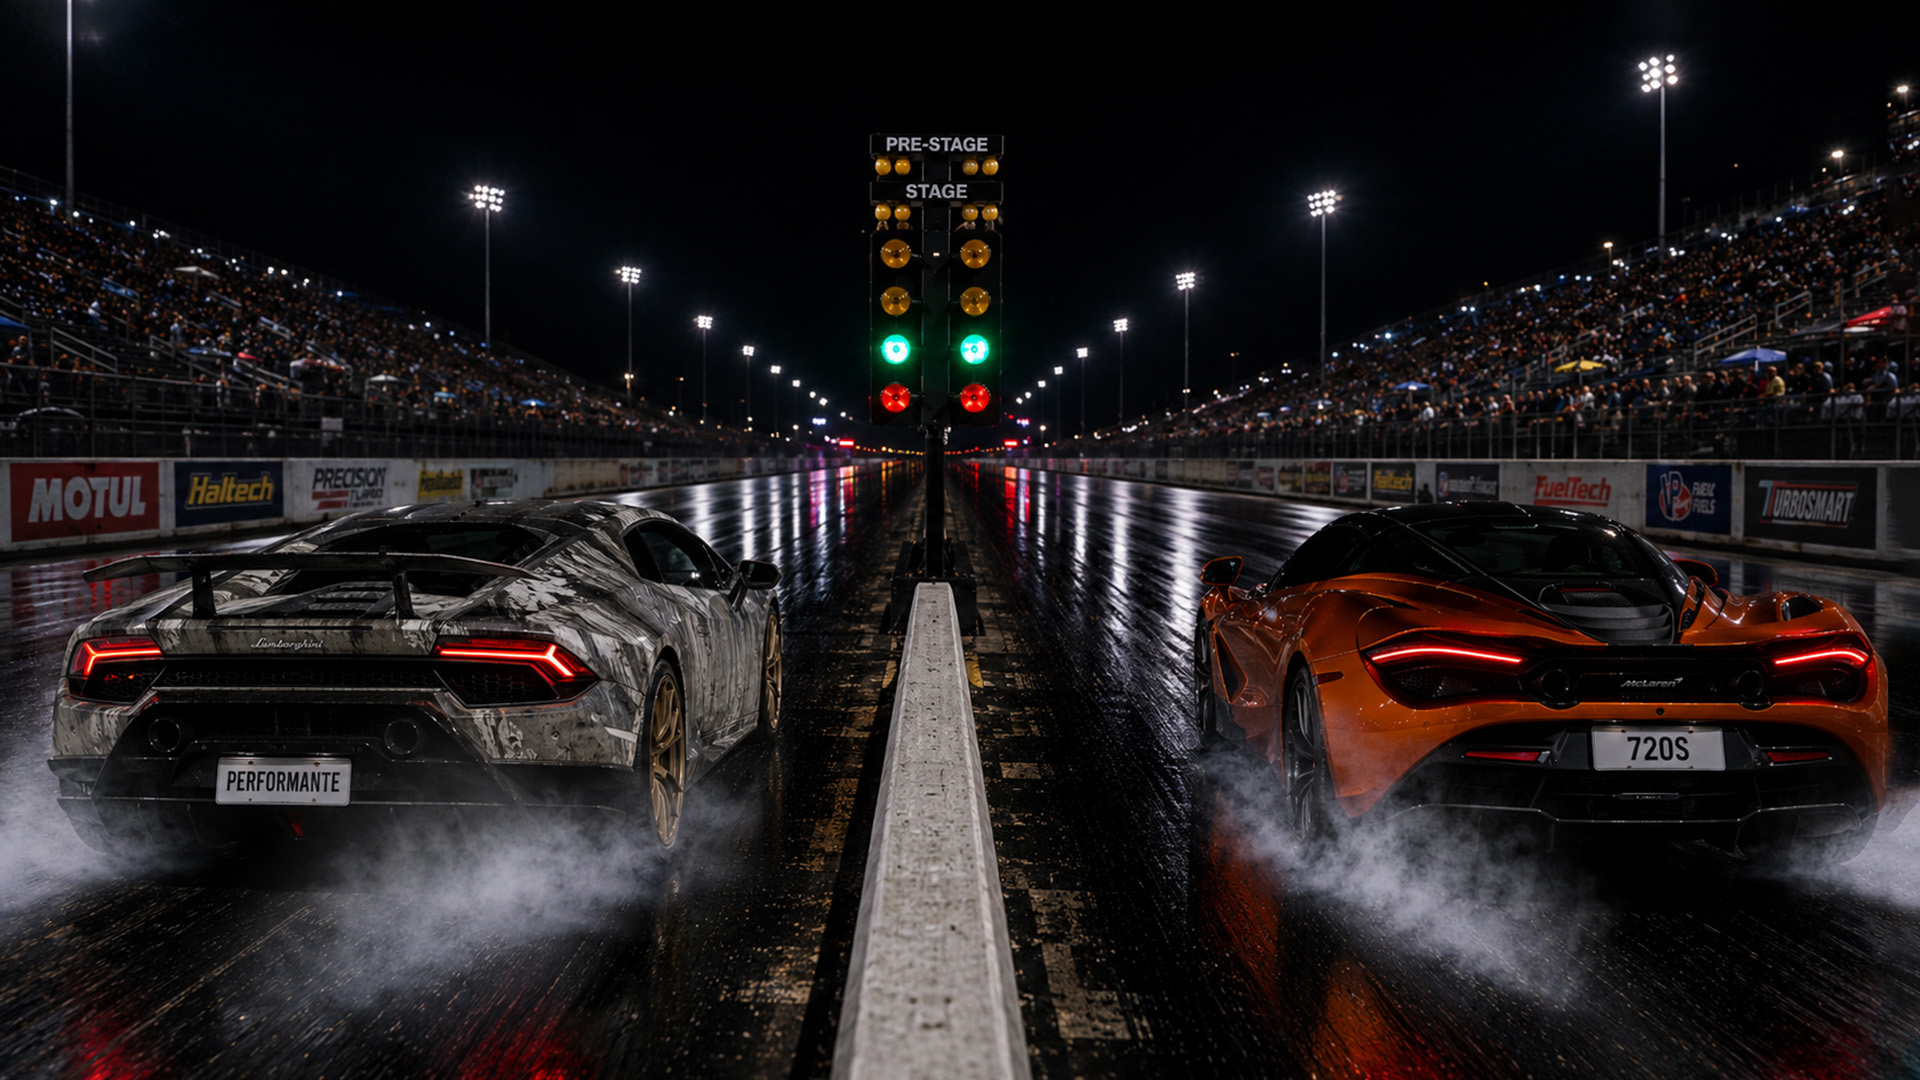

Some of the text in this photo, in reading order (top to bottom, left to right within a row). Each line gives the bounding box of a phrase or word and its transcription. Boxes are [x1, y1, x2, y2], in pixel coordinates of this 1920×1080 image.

[886, 136, 988, 152] PRE-STAGE
[905, 183, 968, 199] STAGE
[187, 475, 273, 505] Haltech
[312, 467, 387, 490] PRECISION
[1534, 475, 1612, 501] FuelTech
[28, 475, 147, 523] MOTUL
[1758, 480, 1855, 523] TURBOSMART
[251, 637, 324, 650] Lamborghini
[1620, 679, 1678, 688] McLaren
[1627, 736, 1690, 761] 720S
[226, 770, 341, 793] PERFORMANTE
